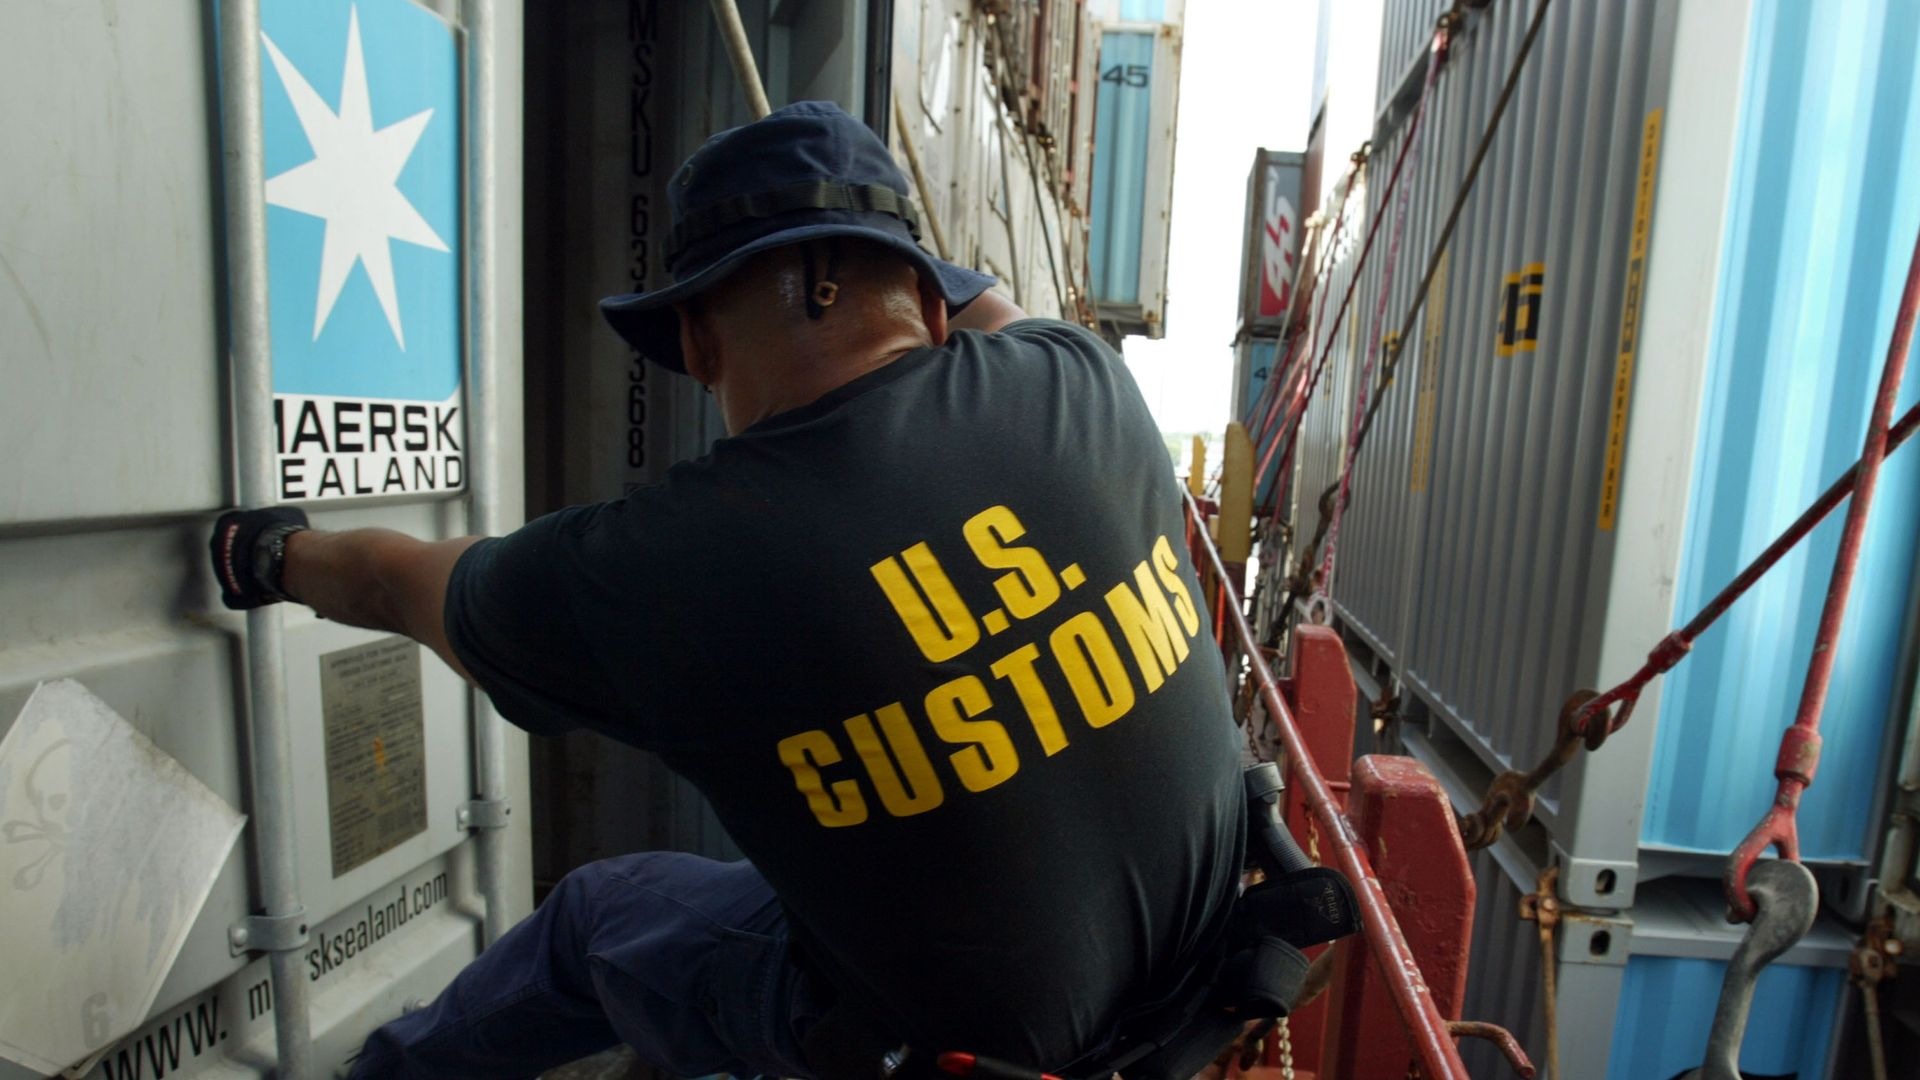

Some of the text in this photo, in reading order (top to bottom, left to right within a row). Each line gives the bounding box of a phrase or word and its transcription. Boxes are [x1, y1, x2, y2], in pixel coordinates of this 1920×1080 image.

[629, 0, 656, 178] MSKU
[1102, 64, 1148, 88] 45
[281, 456, 462, 499] EALAND
[869, 505, 1087, 663] U.S.
[777, 535, 1199, 828] CUSTOMS
